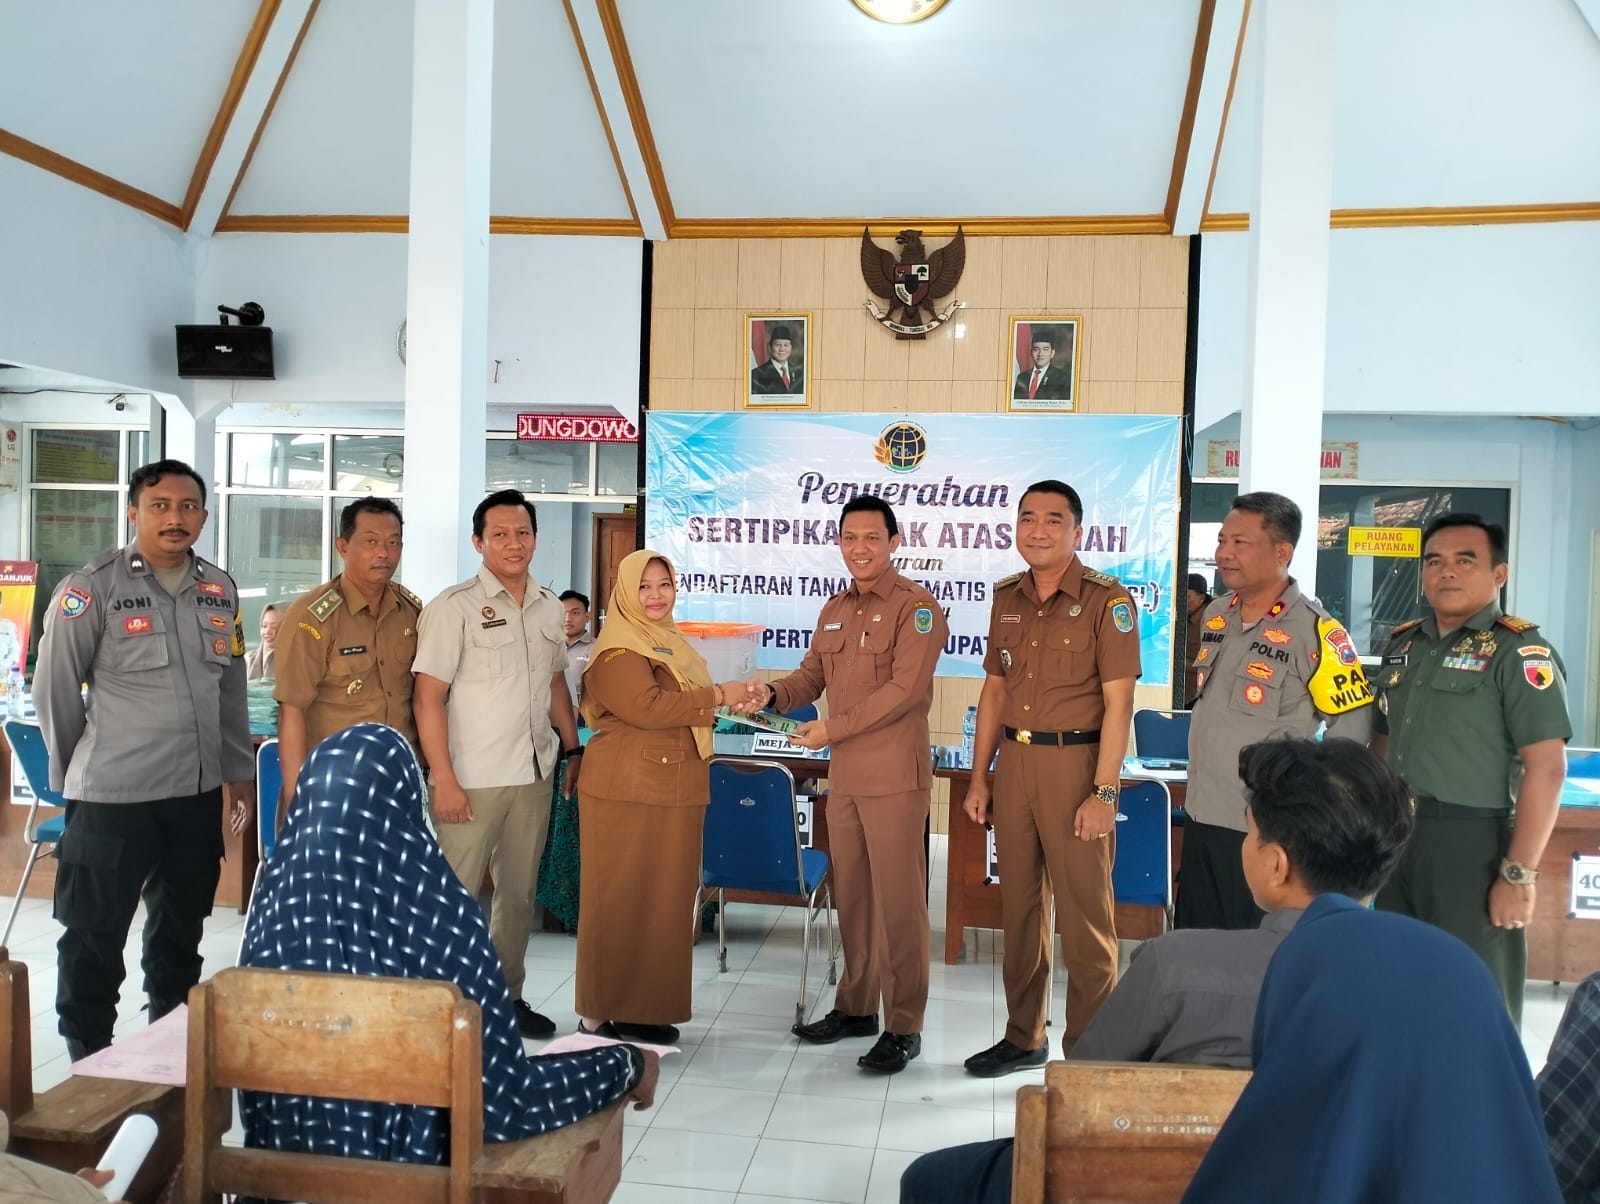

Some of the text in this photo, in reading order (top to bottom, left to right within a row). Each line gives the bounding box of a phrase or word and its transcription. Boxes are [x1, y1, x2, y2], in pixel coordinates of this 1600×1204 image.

[798, 471, 1009, 508] Penyerahan
[688, 516, 841, 546] SERTIPIKA
[897, 521, 928, 548] AK
[937, 522, 1013, 550] ATAS
[1366, 532, 1403, 542] RUANG
[1353, 541, 1415, 552] PELAYANAN
[891, 556, 944, 574] gram
[676, 573, 793, 597] NDAFTARAN
[798, 576, 854, 598] TANA
[113, 596, 152, 611] JONI
[196, 595, 232, 610] POLRI
[1249, 641, 1290, 664] POLRI
[1333, 666, 1368, 691] PA
[1330, 682, 1373, 708] WILA
[758, 738, 793, 749] MEJA
